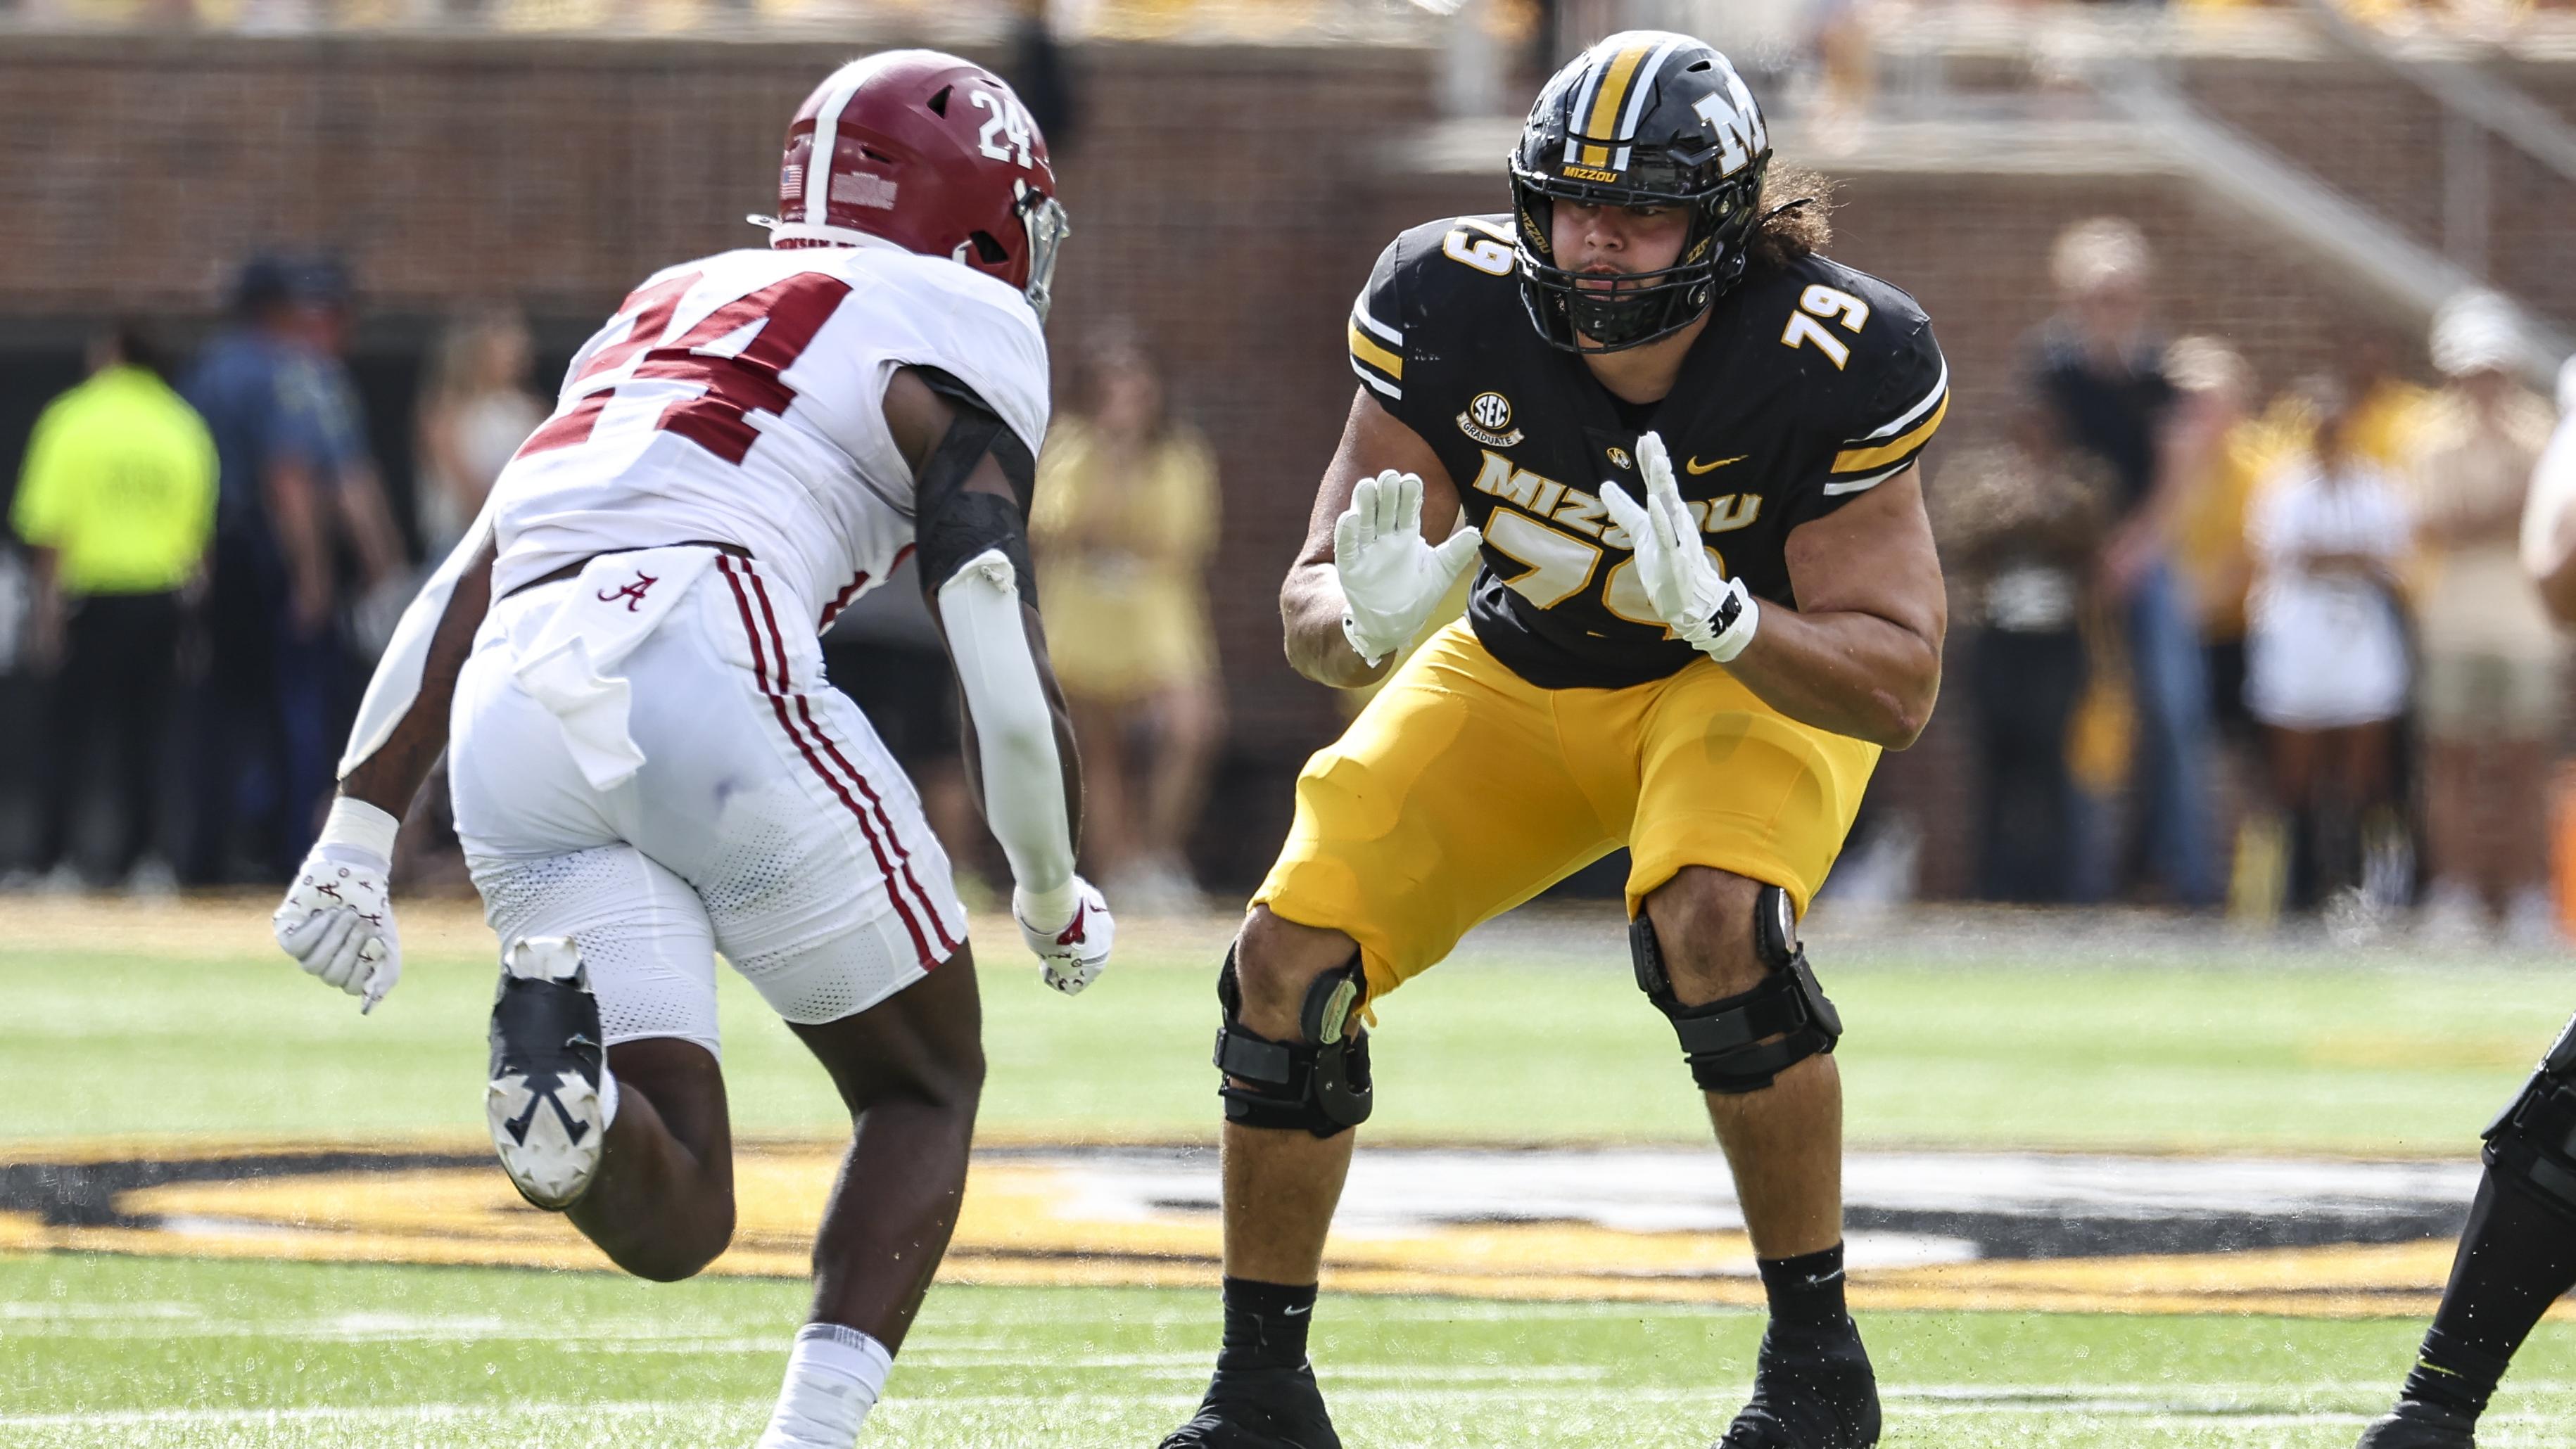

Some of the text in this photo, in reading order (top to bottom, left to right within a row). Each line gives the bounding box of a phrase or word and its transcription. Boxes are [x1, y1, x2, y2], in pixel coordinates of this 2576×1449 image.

[969, 89, 1033, 170] 24
[1692, 72, 1769, 179] M
[1563, 166, 1618, 183] MIZZOU
[1780, 284, 1870, 371] 79
[515, 270, 854, 466] 24
[1464, 422, 1513, 445] GRADUATE
[1474, 395, 1507, 428] SEC
[597, 570, 659, 611] A
